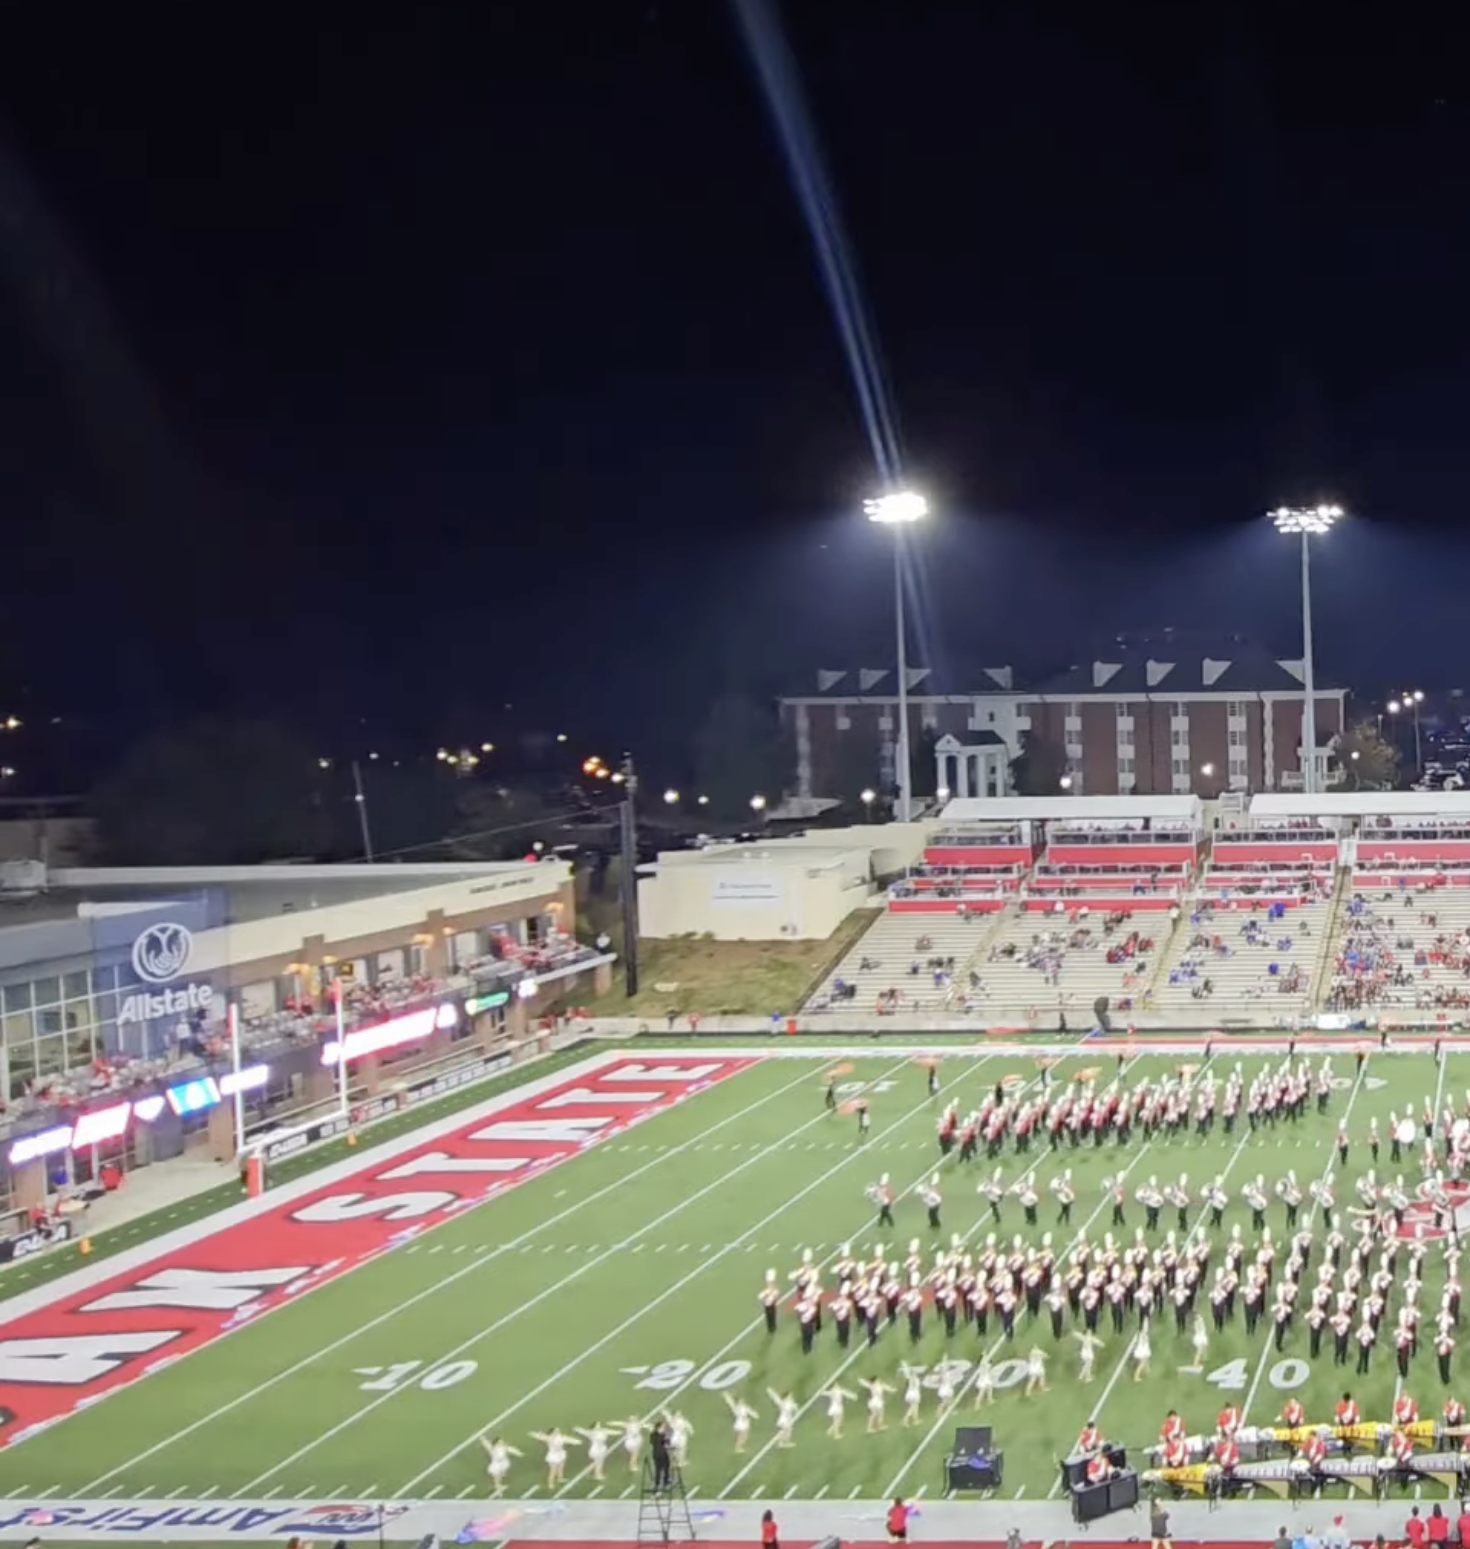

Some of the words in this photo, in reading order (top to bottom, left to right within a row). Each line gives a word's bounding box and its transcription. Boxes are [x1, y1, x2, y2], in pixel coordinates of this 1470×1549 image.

[116, 982, 213, 1026] Allstate
[291, 1062, 727, 1222] STATE
[358, 1360, 479, 1391] 10
[633, 1359, 752, 1391] 20
[1206, 1357, 1311, 1389] 40
